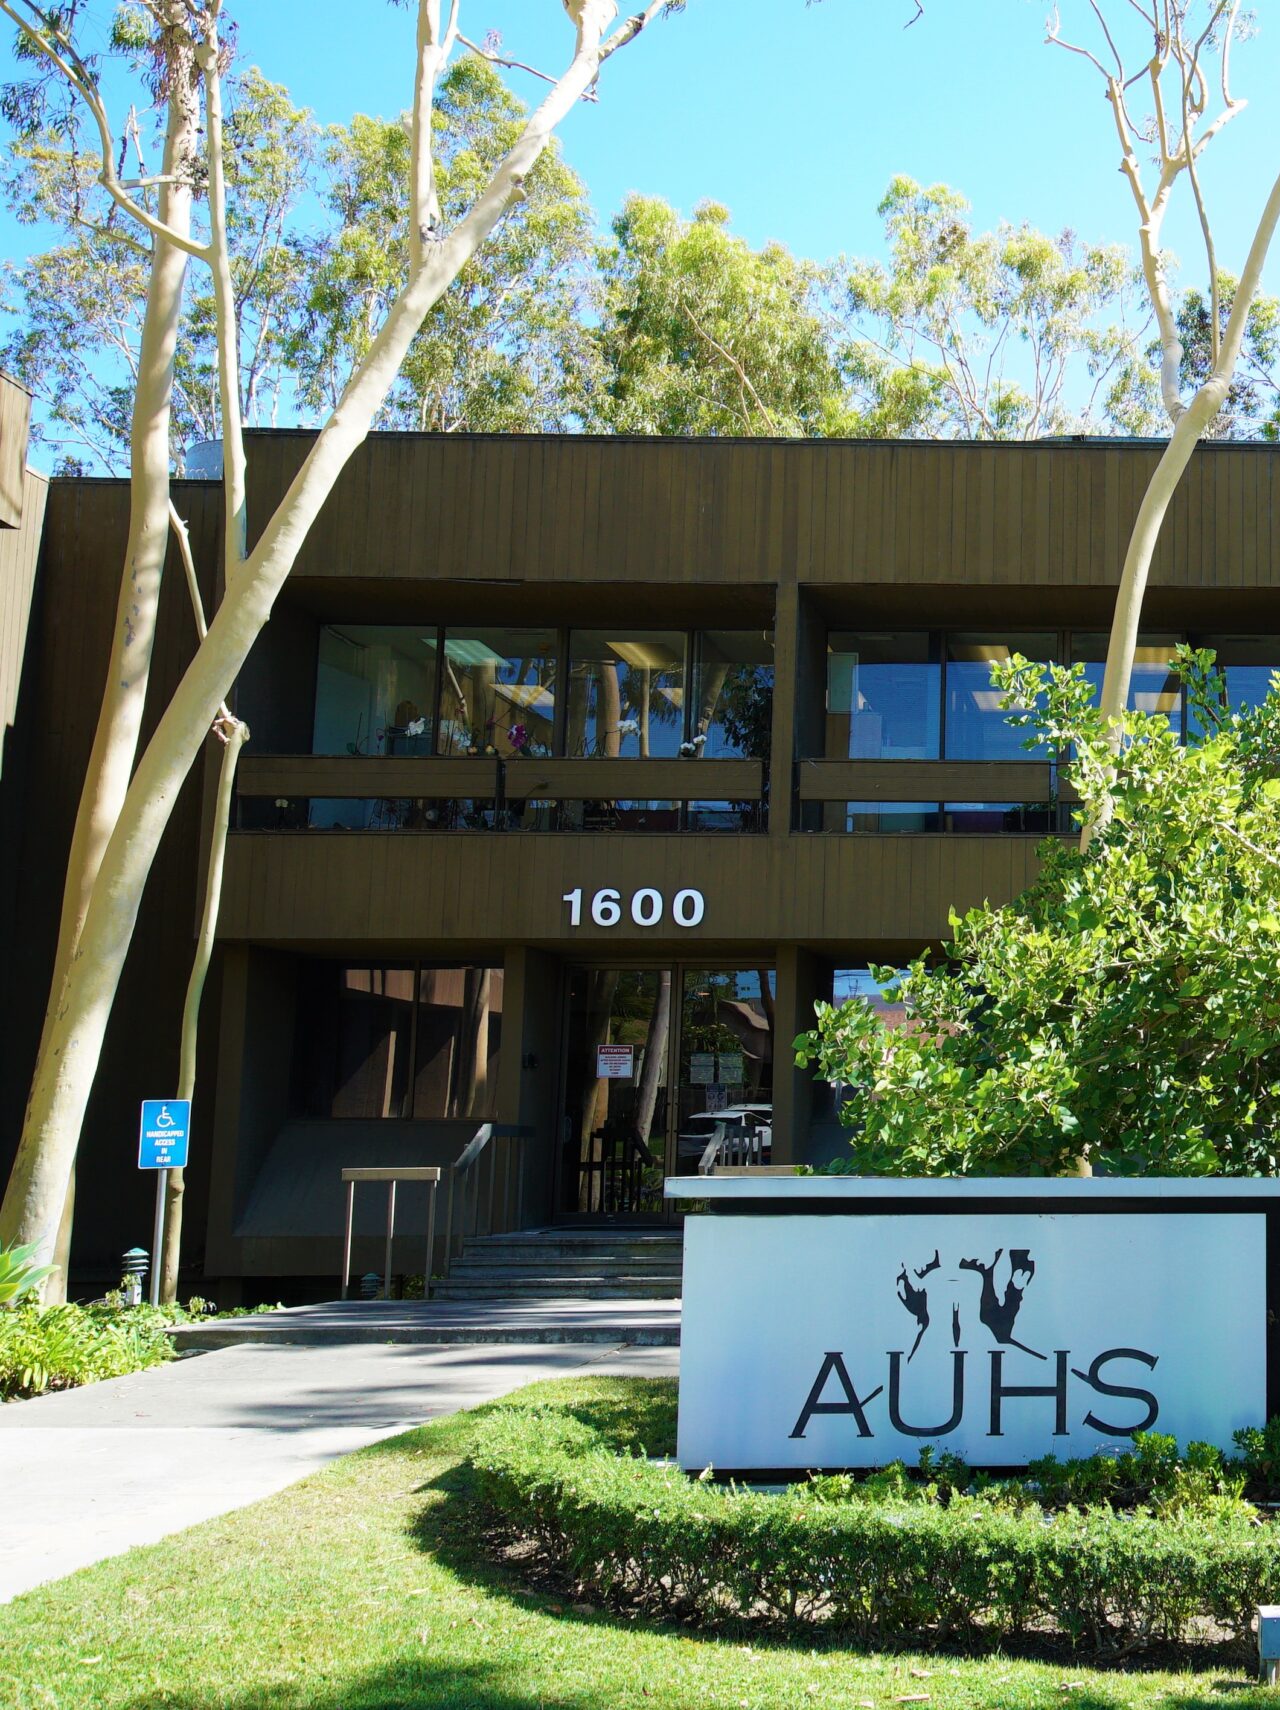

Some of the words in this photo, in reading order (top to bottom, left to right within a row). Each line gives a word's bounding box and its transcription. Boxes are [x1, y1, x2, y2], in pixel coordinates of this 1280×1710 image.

[563, 888, 705, 927] 1600
[146, 1130, 184, 1138] HANDICAPPED
[788, 1348, 1159, 1438] AUHS
